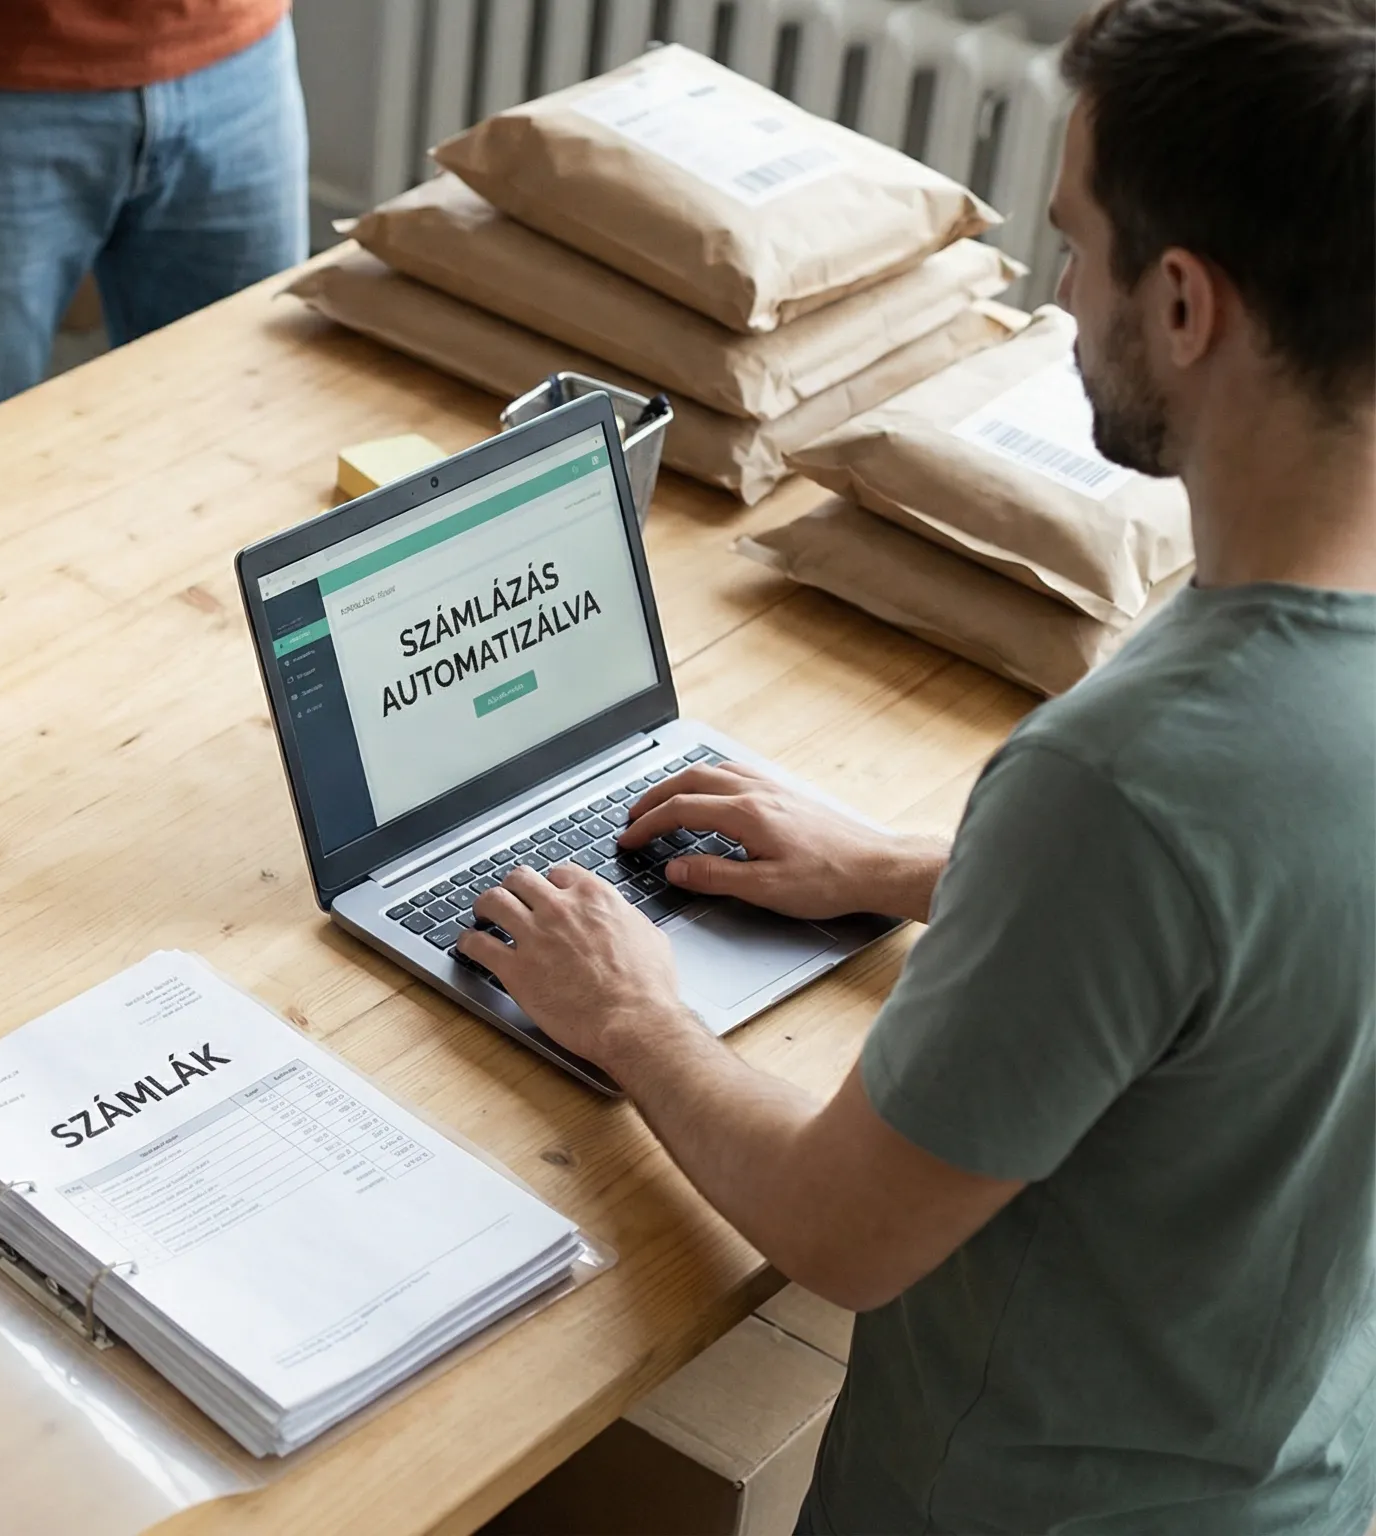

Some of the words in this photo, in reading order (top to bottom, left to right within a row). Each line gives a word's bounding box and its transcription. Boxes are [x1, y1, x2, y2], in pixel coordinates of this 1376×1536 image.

[382, 590, 602, 718] AUTOMATIZÁLVA
[399, 562, 560, 658] SZÁMLÁZÁS
[50, 1042, 233, 1149] SZÁMLÁK
